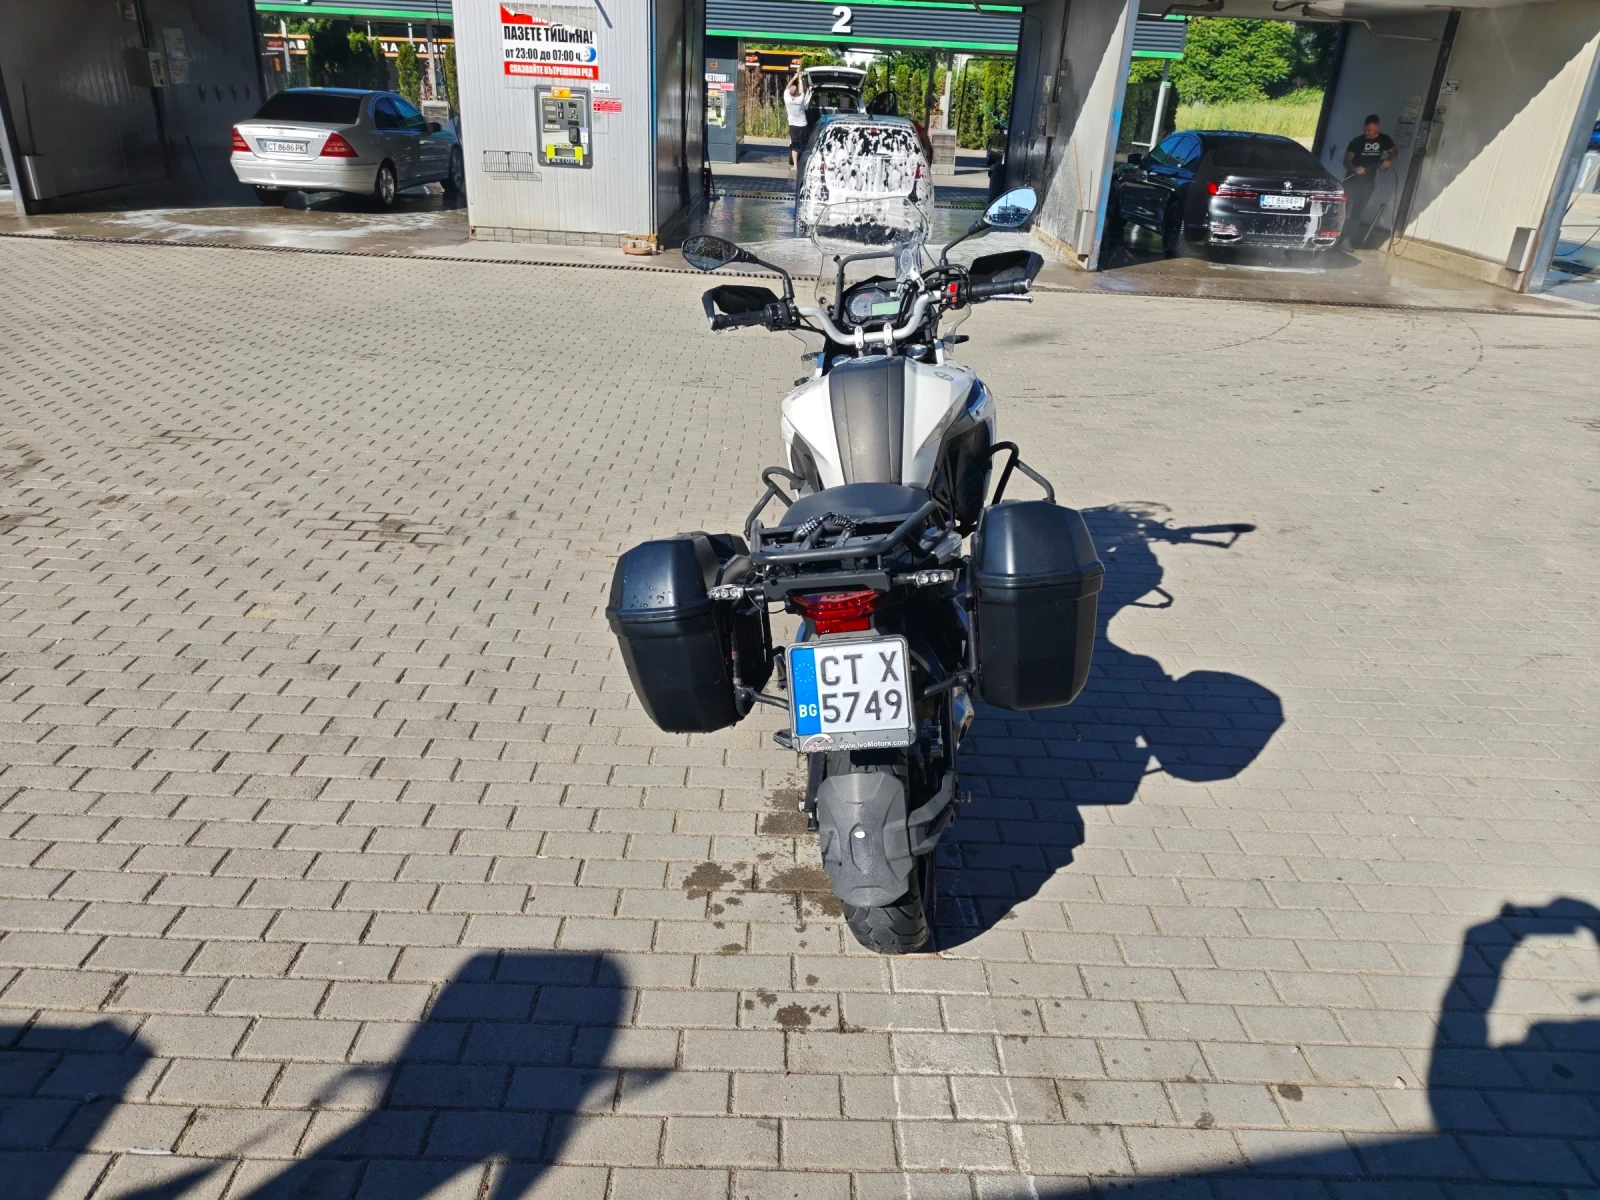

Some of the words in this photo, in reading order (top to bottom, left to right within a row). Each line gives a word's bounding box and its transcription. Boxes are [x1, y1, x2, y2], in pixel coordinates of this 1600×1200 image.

[832, 5, 852, 33] 2
[503, 25, 542, 41] ПАЗЕТЕ
[544, 27, 593, 44] ТИШИНА!
[505, 49, 514, 58] от
[515, 47, 538, 60] 23:00
[540, 50, 551, 62] до
[552, 49, 574, 61] 07:00
[581, 68, 594, 78] РЕД
[267, 143, 276, 151] CT
[278, 143, 294, 152] 8686
[295, 144, 305, 152] PK
[1364, 142, 1380, 151] DG
[1265, 196, 1276, 204] CT
[819, 653, 863, 686] CT
[878, 650, 900, 683] X
[798, 703, 818, 718] BG
[821, 688, 902, 724] 5749
